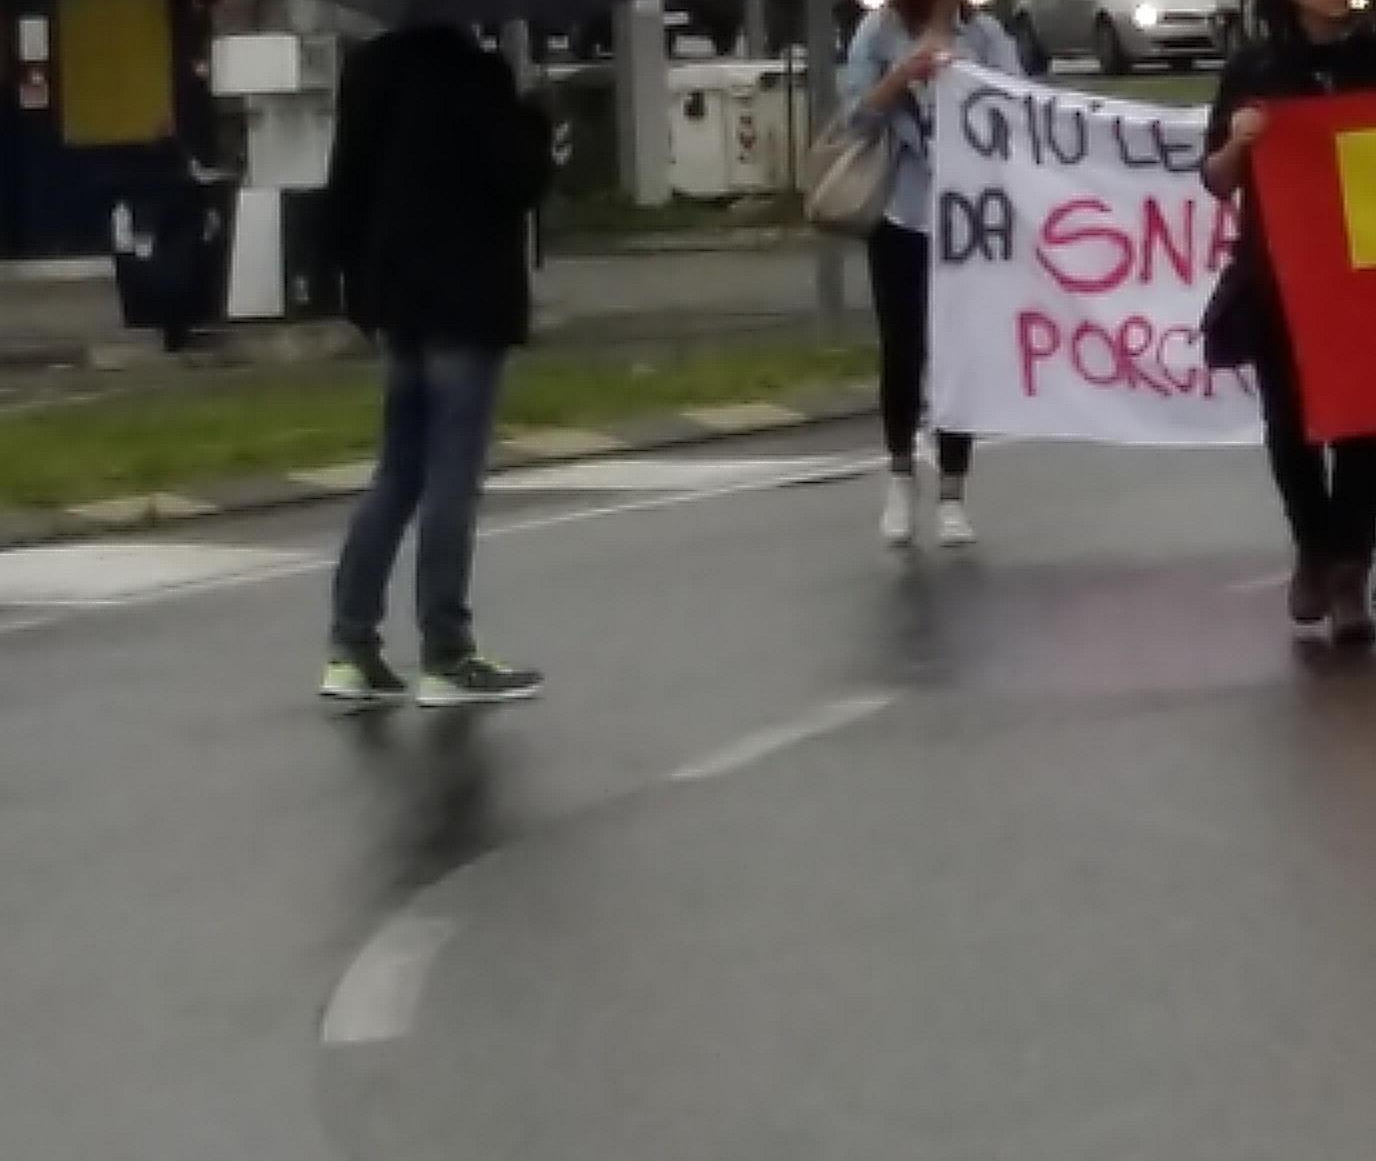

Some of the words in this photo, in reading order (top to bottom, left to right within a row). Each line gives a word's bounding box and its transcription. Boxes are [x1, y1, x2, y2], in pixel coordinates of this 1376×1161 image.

[940, 188, 1014, 264] DA
[1035, 193, 1241, 293] SNA
[1015, 310, 1257, 399] PORC
